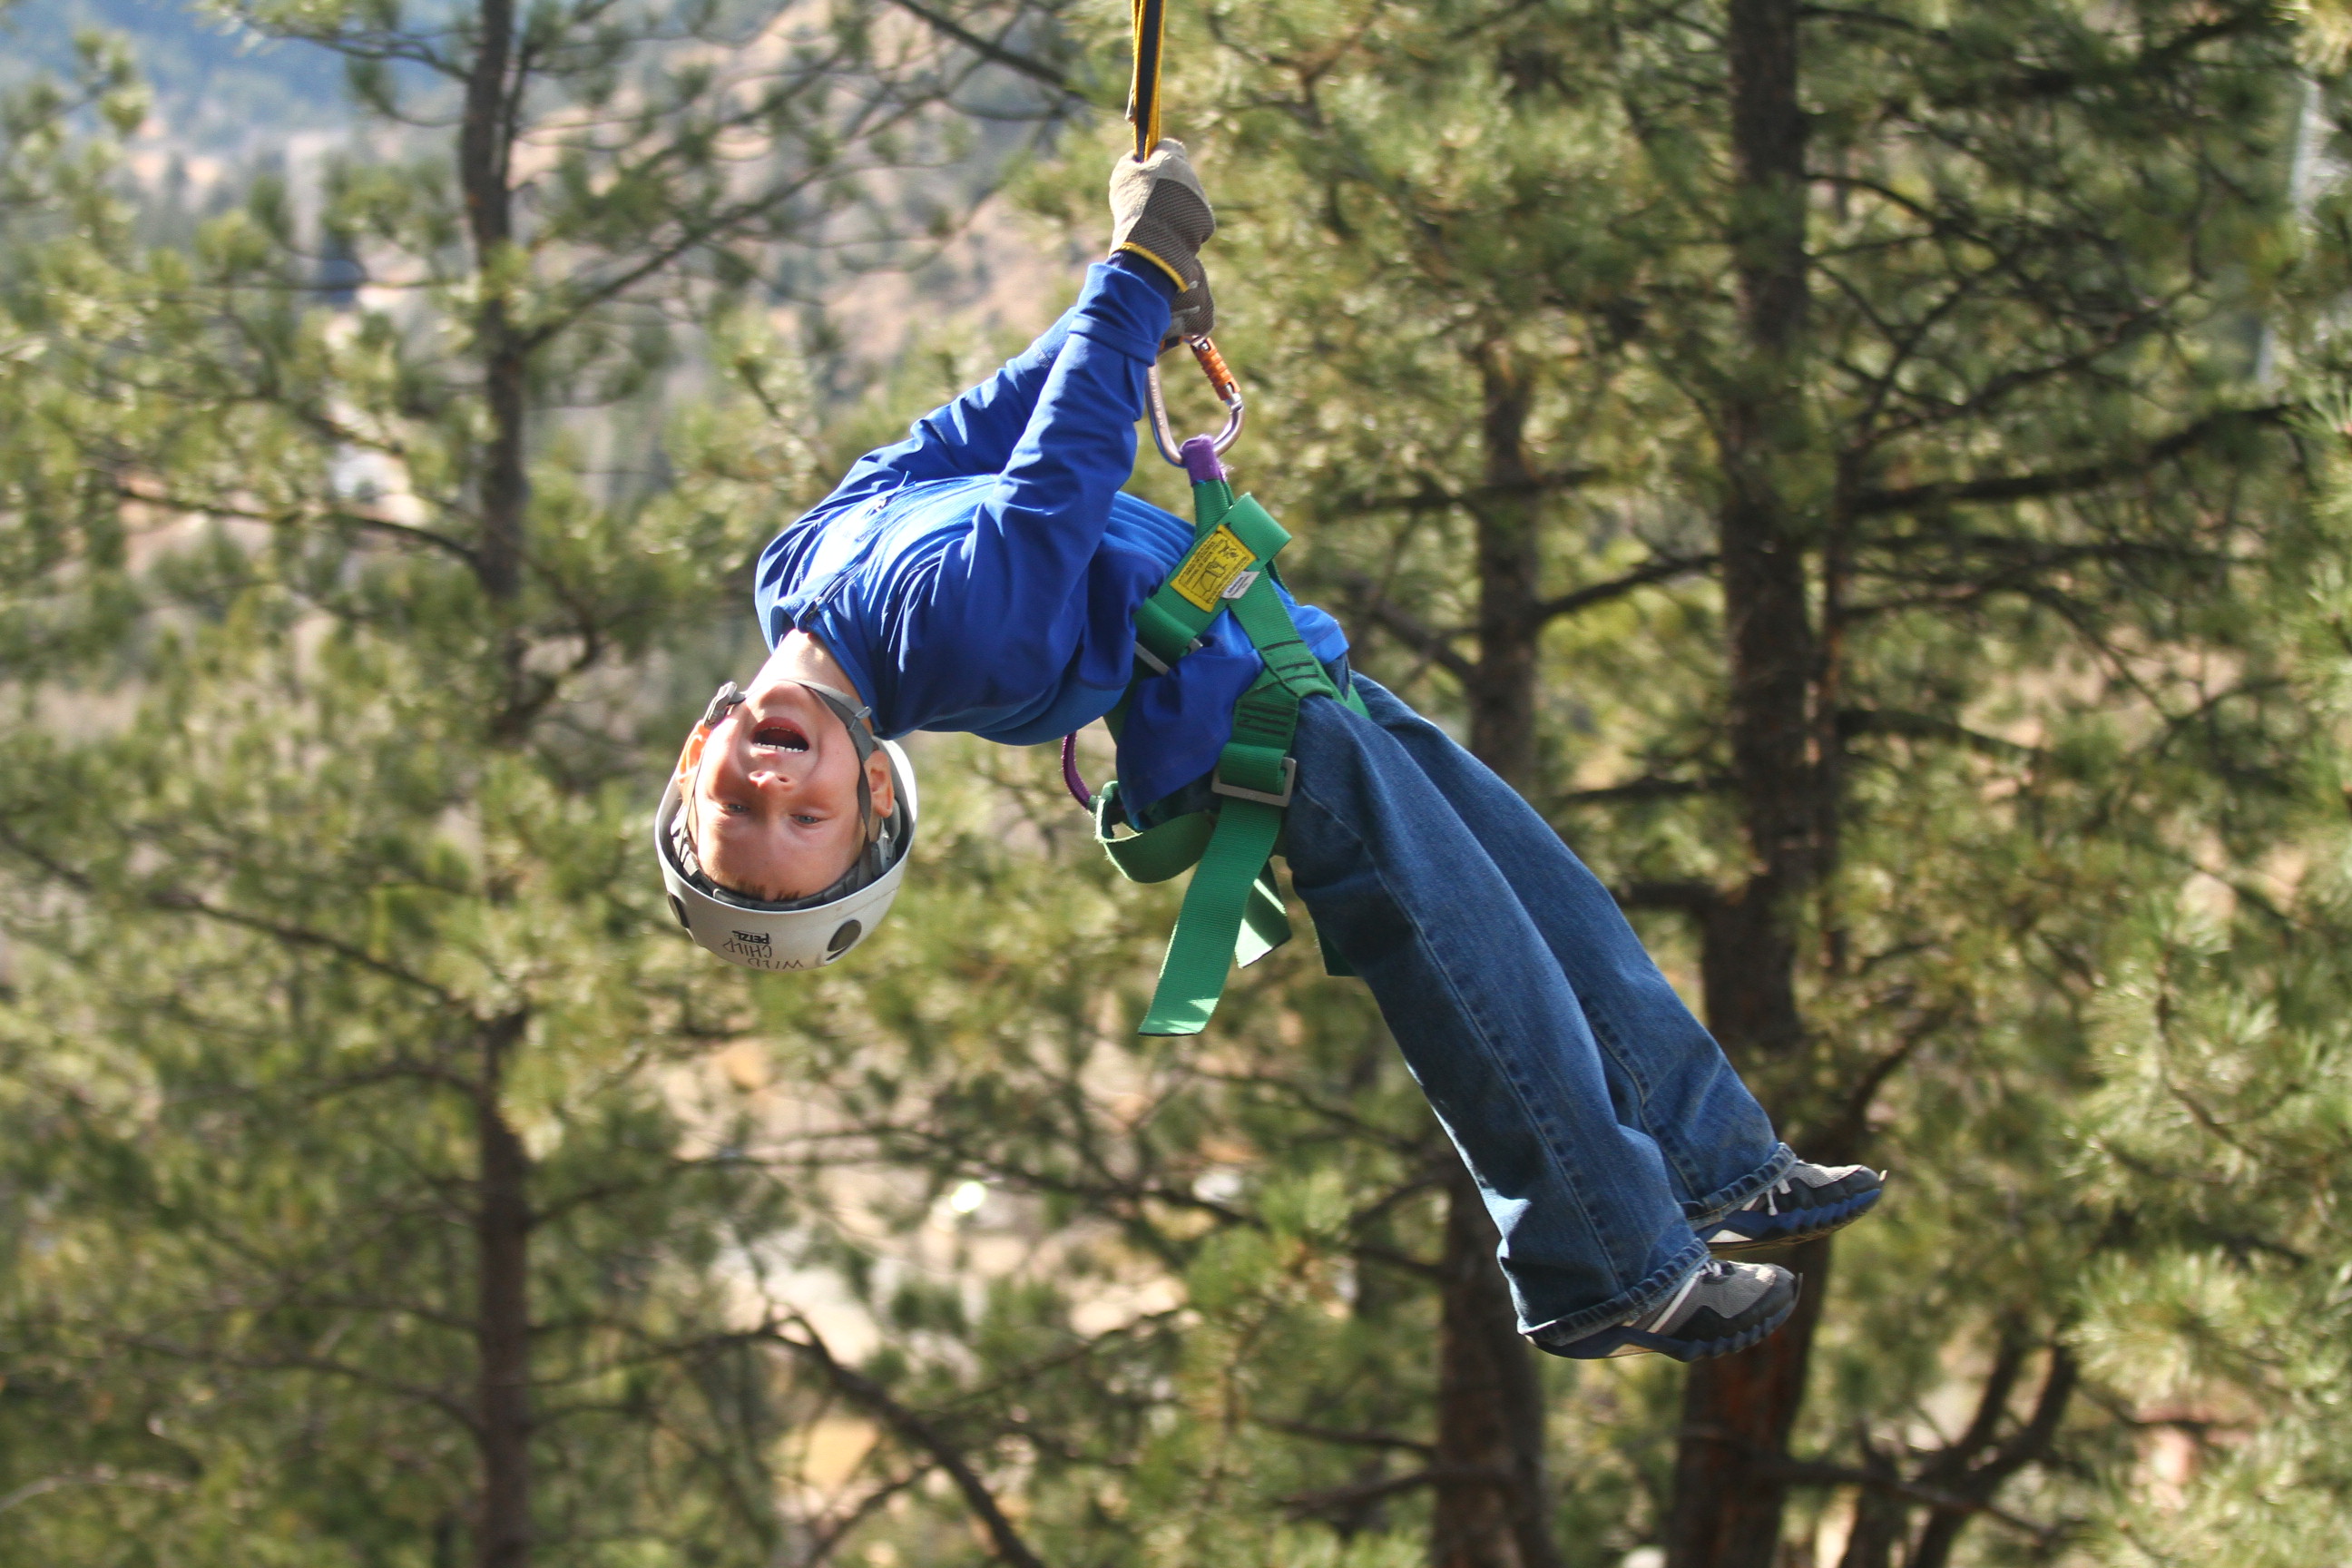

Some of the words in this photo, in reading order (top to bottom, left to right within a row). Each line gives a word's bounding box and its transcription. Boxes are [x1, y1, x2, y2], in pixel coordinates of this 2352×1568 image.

[731, 930, 770, 945] PETZL
[722, 937, 772, 959] CHILD
[747, 957, 803, 970] WILD
